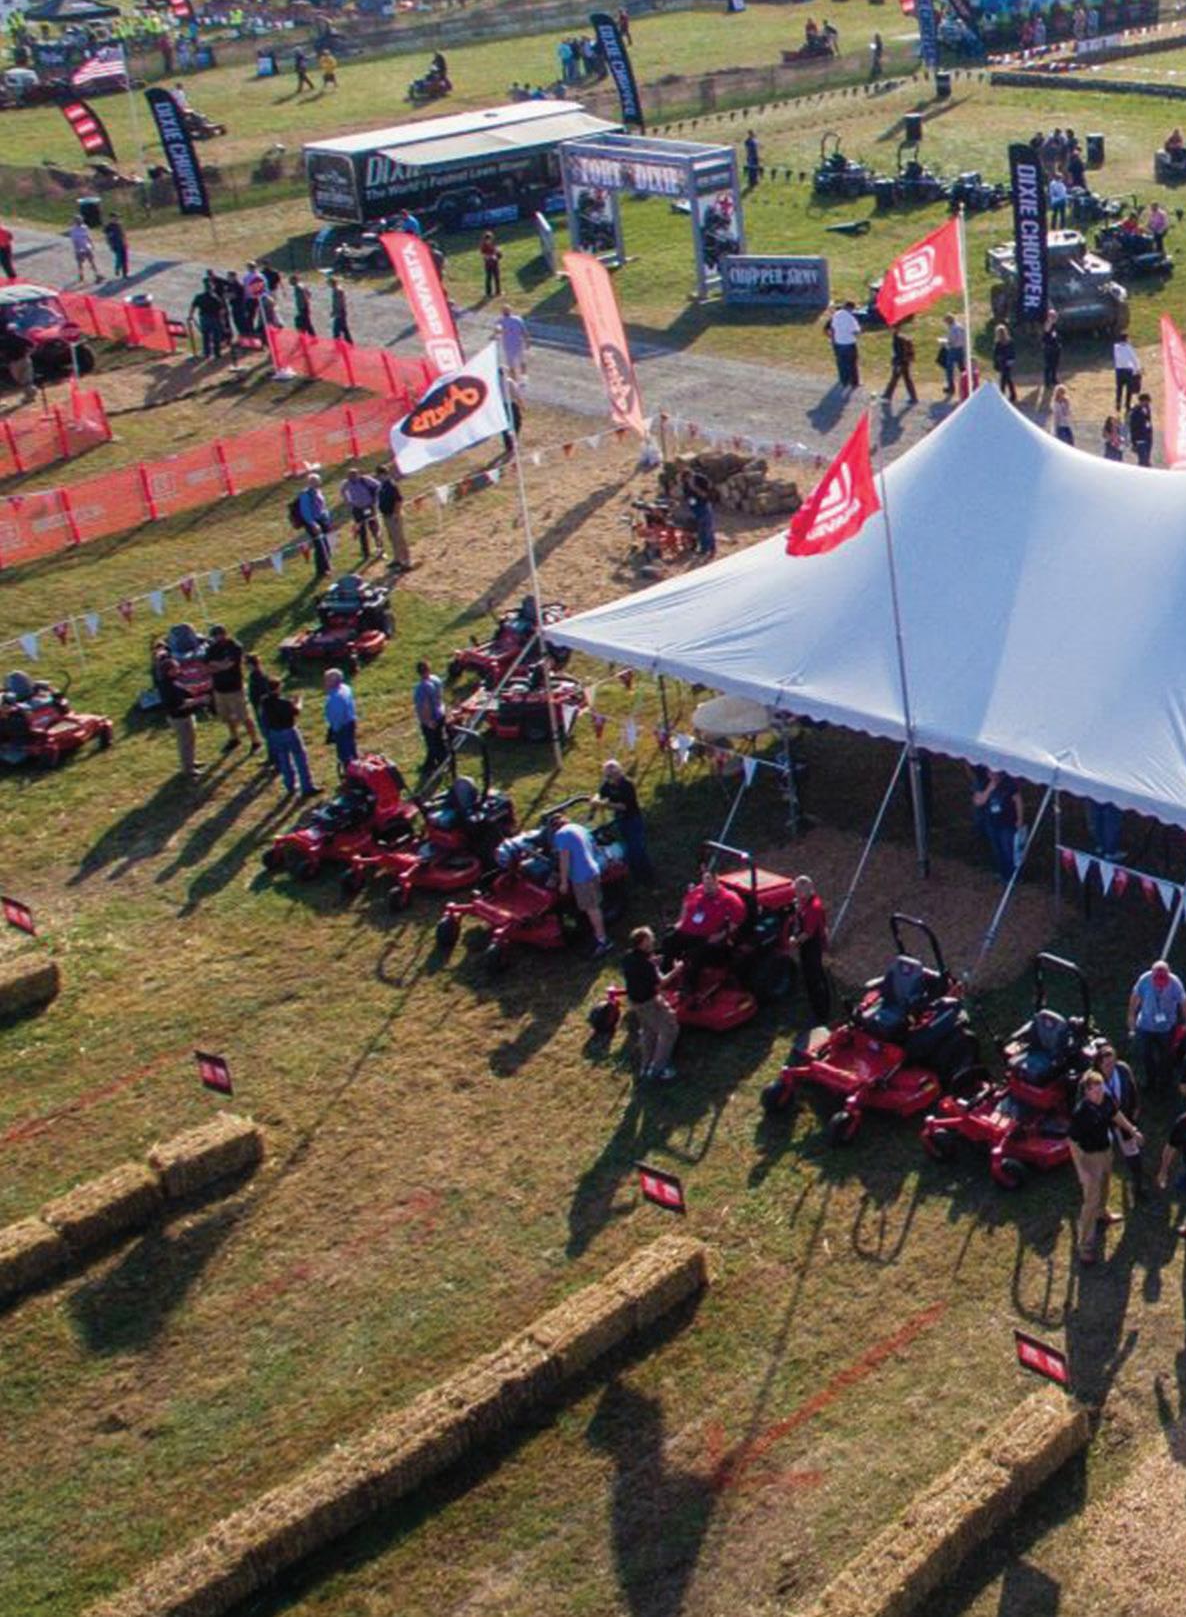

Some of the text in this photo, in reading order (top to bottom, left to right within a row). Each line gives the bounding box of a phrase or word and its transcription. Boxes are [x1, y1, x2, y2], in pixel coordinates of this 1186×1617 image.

[598, 25, 636, 115] DIXIE CHOPPER
[155, 101, 203, 208] DIXIE CHOPPER
[1016, 164, 1043, 308] DIXIE CHOPPER
